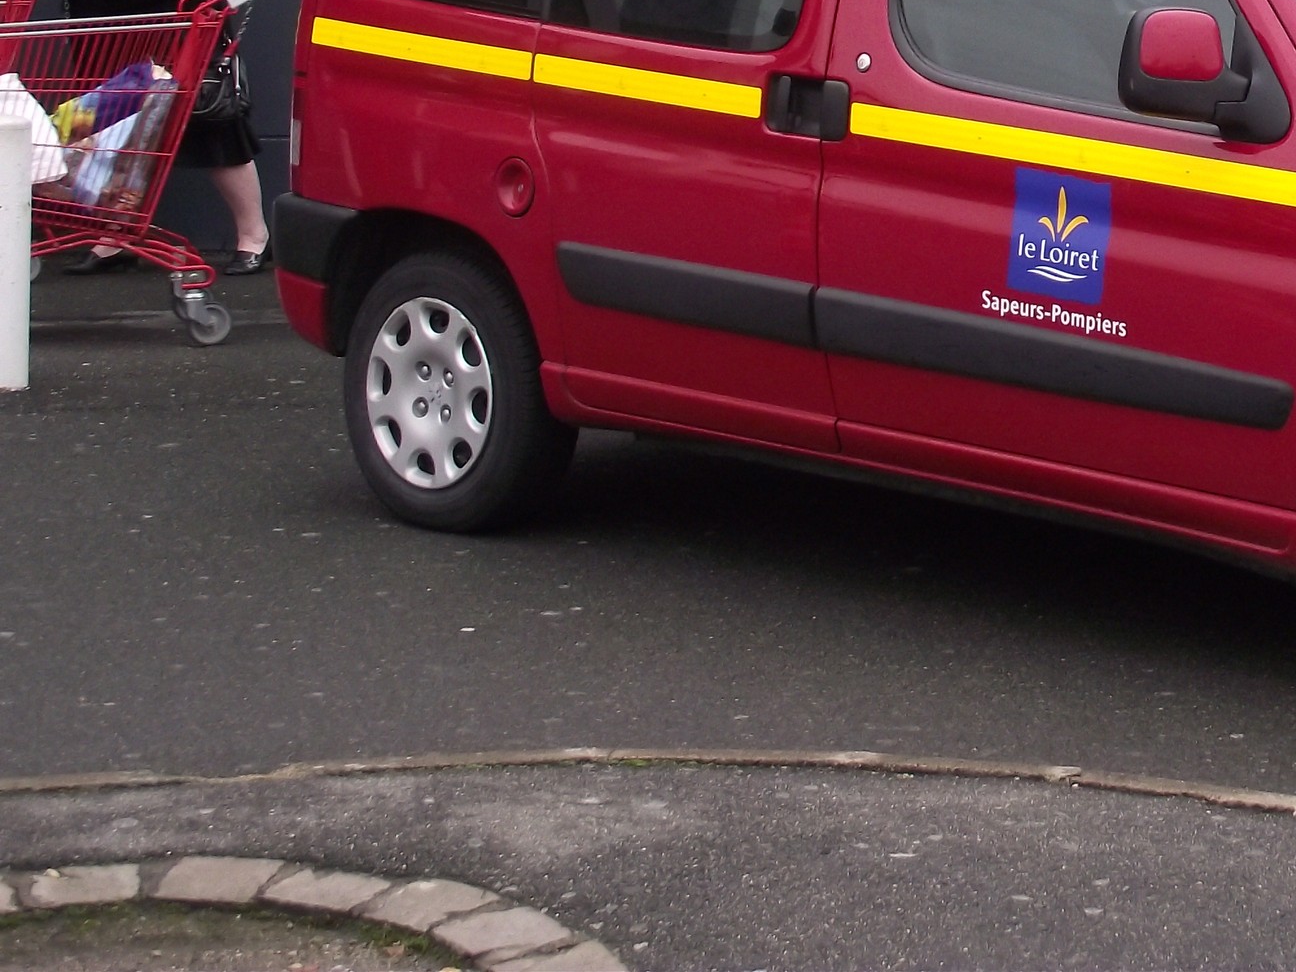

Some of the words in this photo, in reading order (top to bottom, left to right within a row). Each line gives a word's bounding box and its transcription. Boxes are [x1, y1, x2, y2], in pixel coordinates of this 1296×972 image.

[1018, 233, 1037, 259] le
[1039, 239, 1100, 272] Loiret
[981, 289, 1128, 338] Sapeurs-Pompiers
